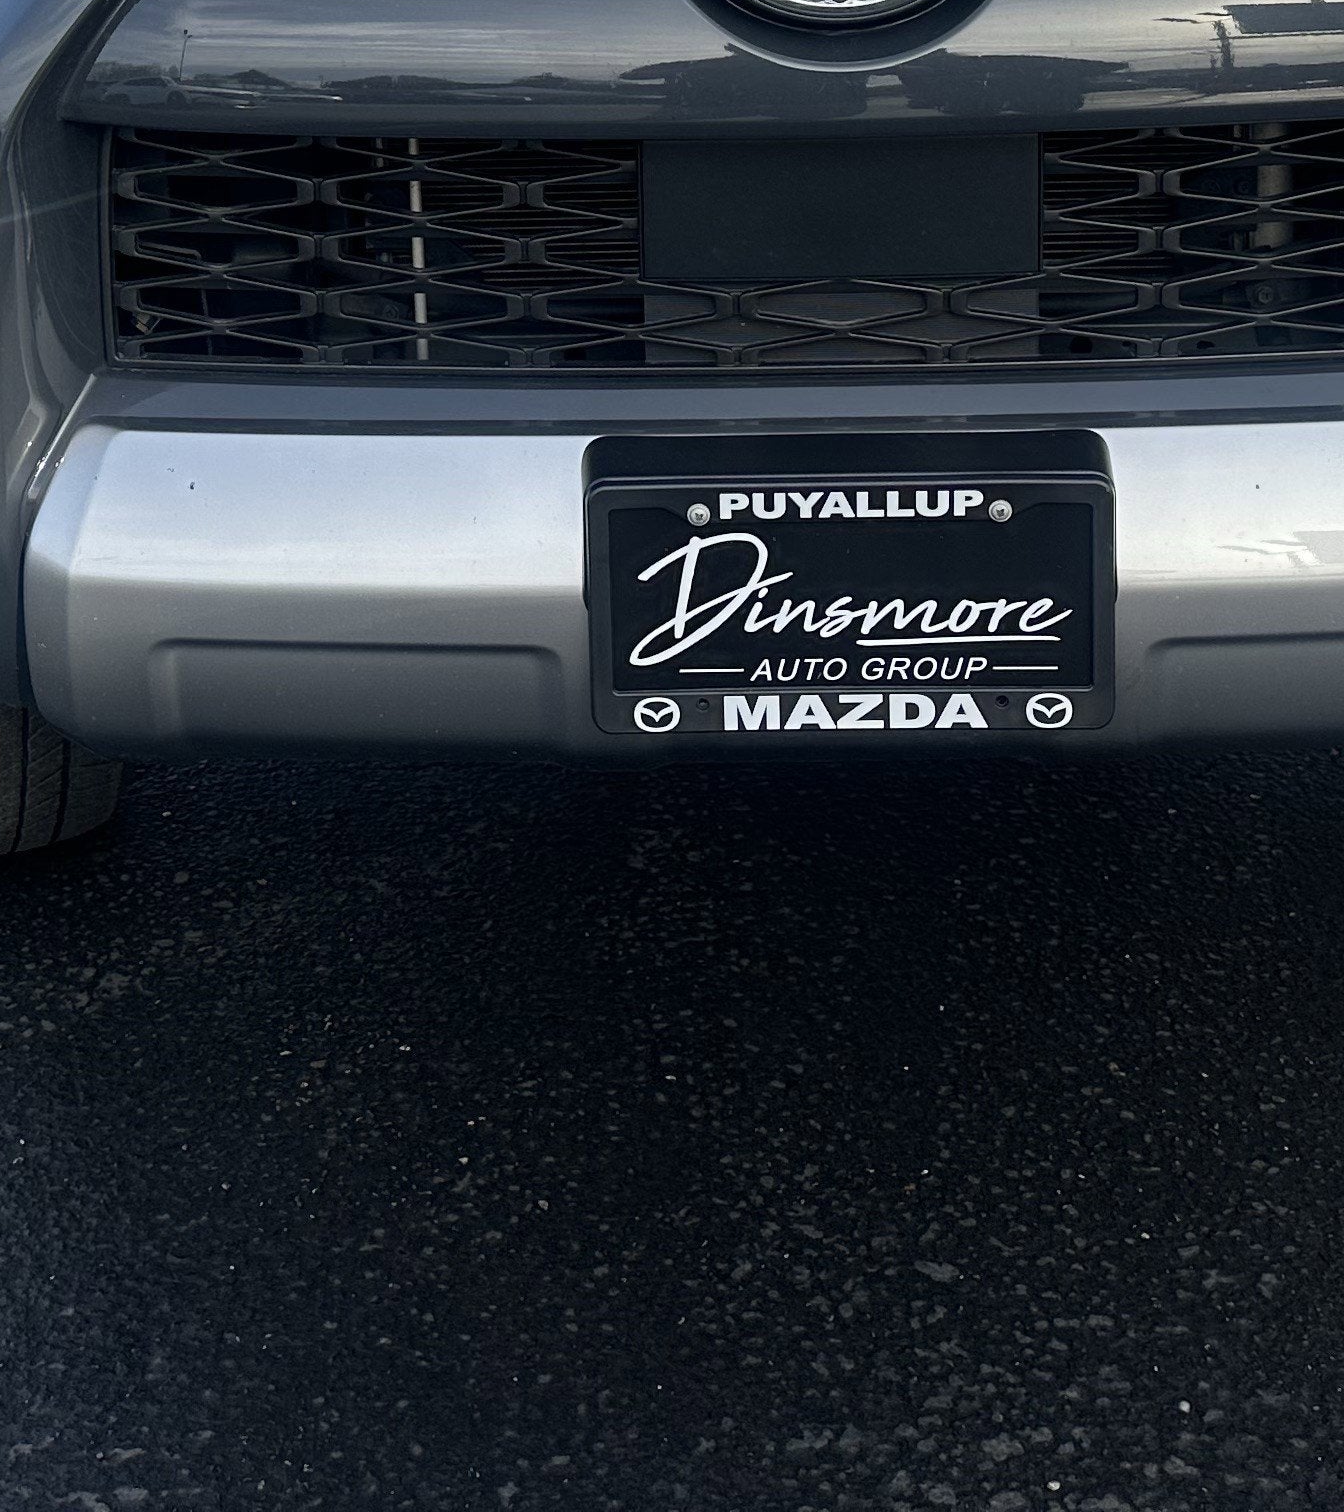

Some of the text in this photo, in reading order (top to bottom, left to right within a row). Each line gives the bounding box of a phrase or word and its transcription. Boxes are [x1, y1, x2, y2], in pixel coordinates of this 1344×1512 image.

[720, 490, 983, 519] PUYALLUP
[629, 532, 1073, 666] Dinsmore
[751, 657, 987, 681] AUTO GROUP
[724, 692, 988, 730] MAZDA
